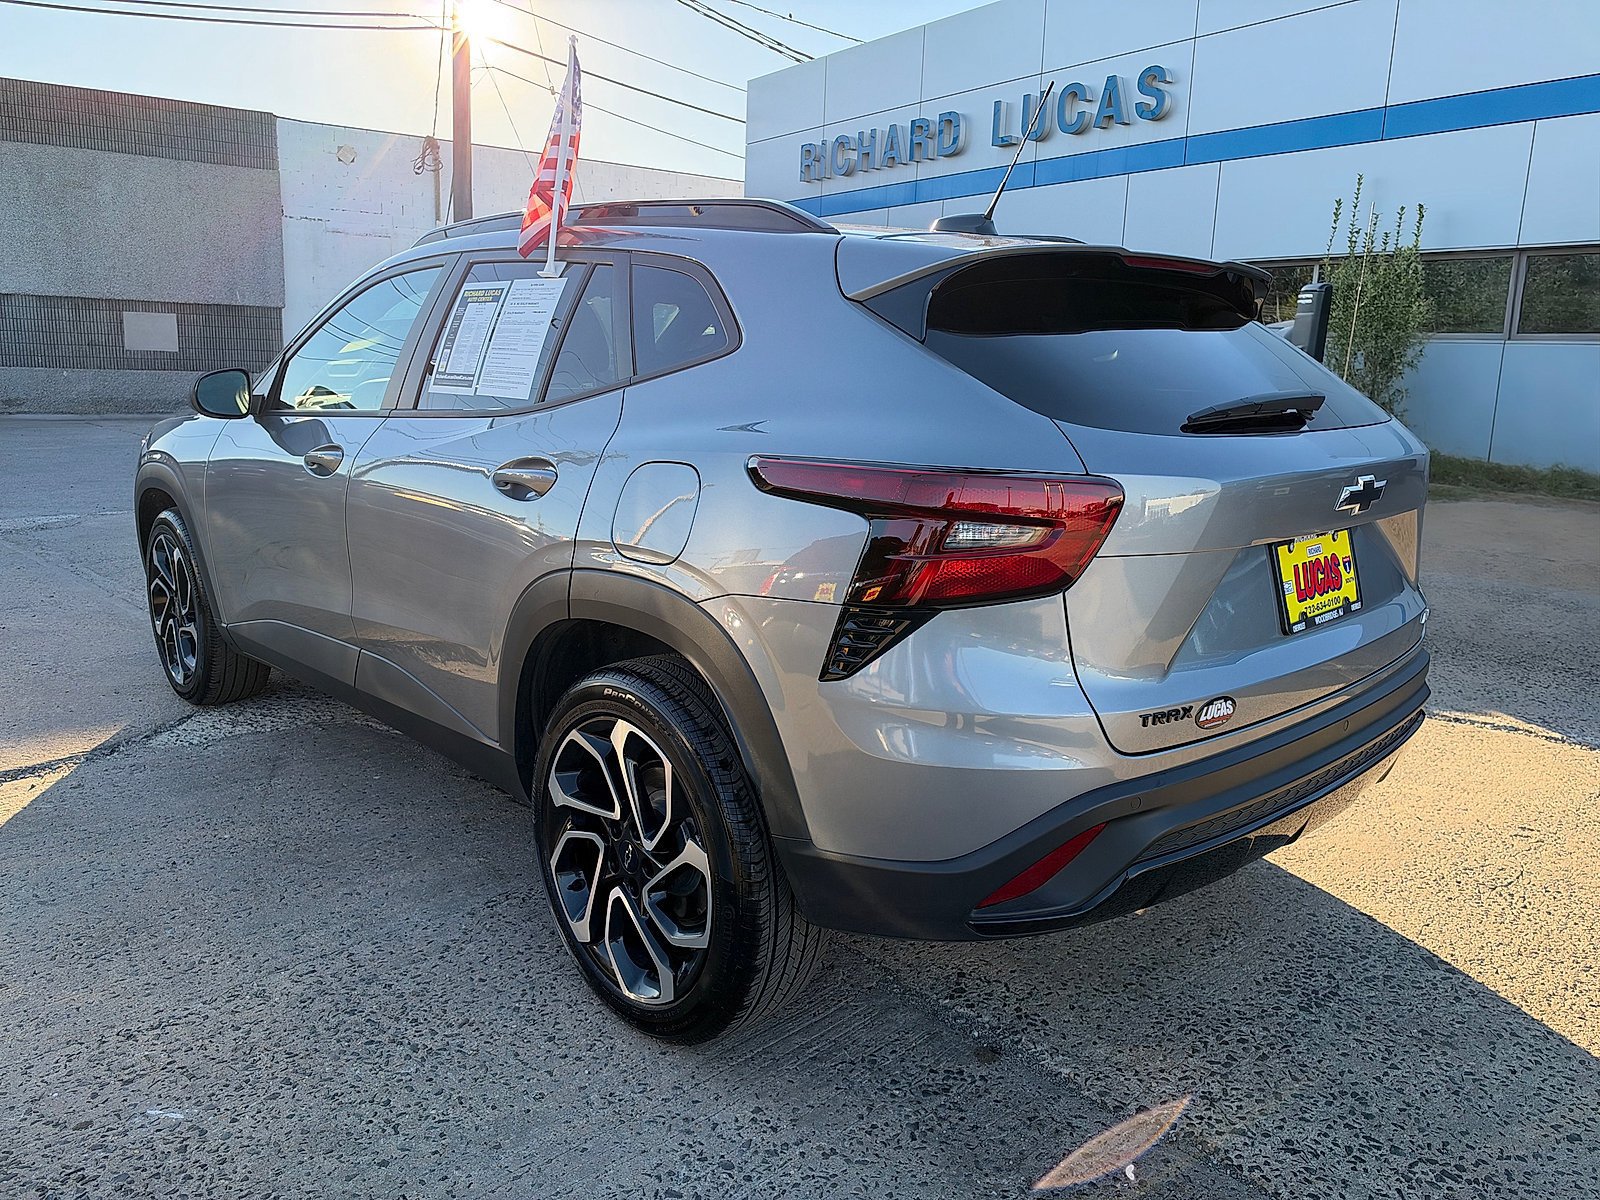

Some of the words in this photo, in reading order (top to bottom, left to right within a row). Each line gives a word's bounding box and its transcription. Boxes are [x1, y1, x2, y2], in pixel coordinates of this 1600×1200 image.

[799, 110, 966, 182] RICHARD
[991, 65, 1174, 148] LUCAS
[1293, 553, 1343, 603] LUCAS
[1345, 562, 1350, 573] 1
[1304, 596, 1341, 614] 732-634-0100
[1138, 705, 1193, 727] TRAX
[1199, 700, 1234, 722] LUCAS
